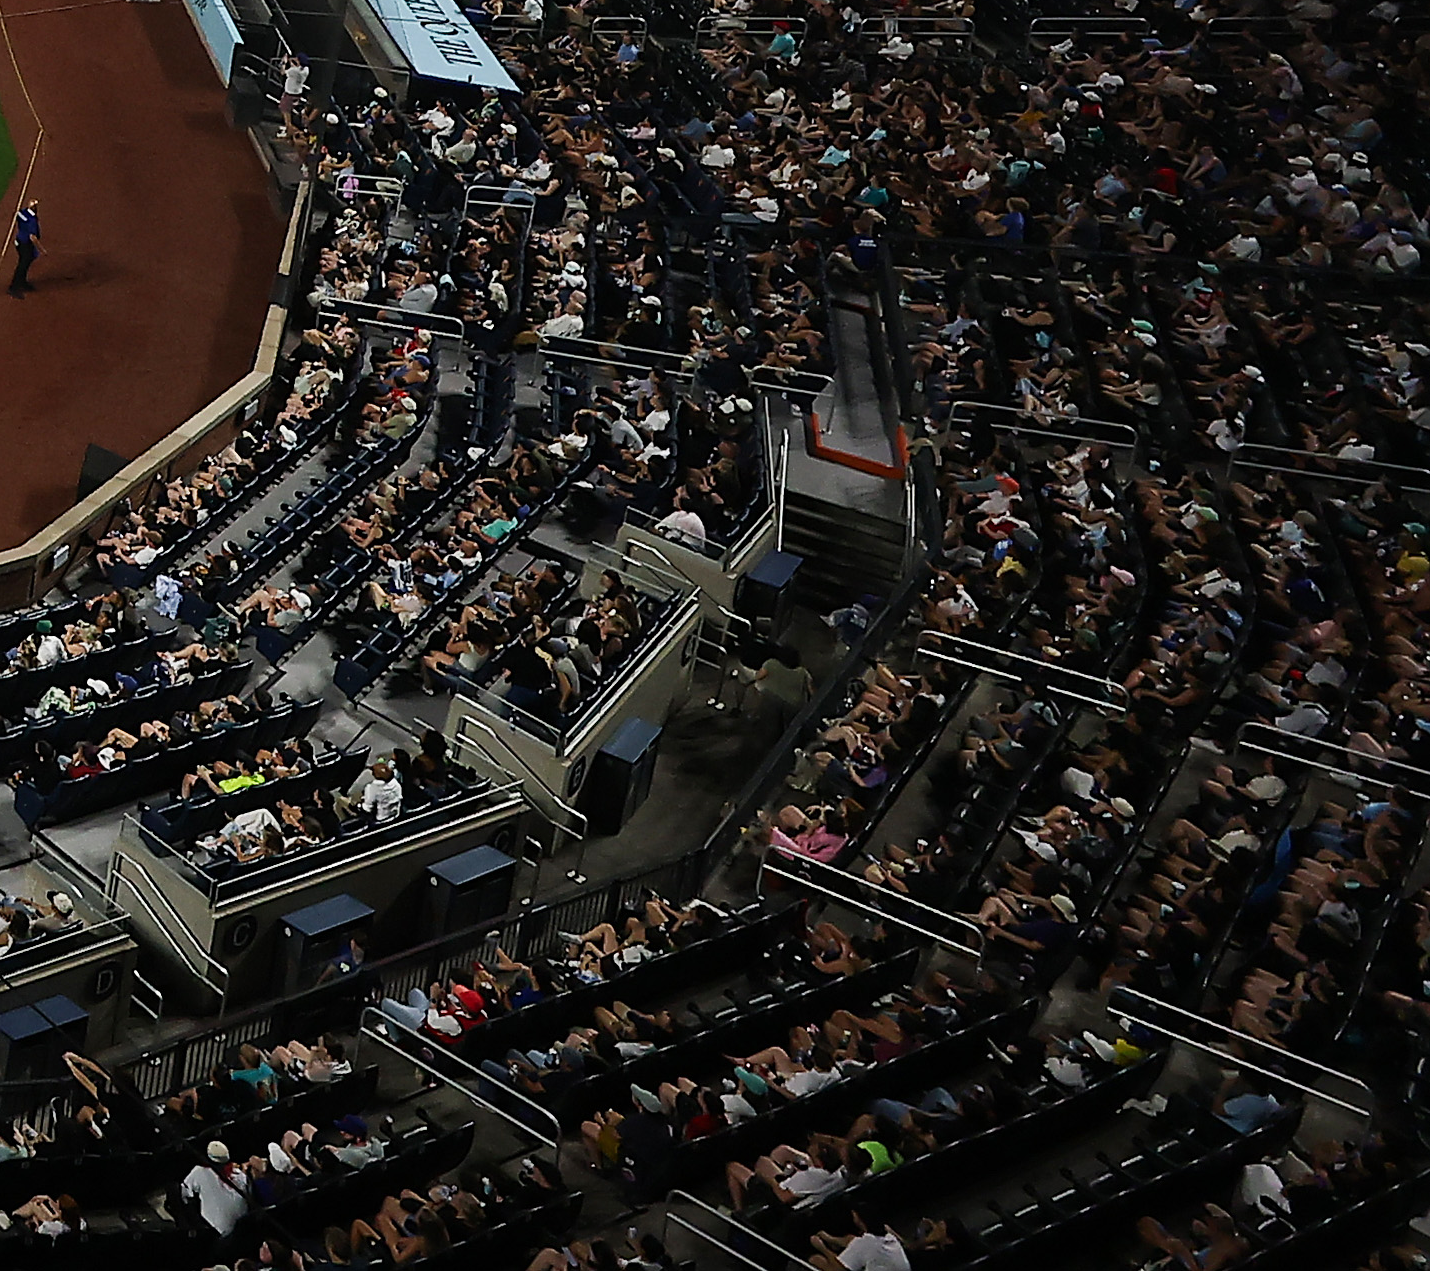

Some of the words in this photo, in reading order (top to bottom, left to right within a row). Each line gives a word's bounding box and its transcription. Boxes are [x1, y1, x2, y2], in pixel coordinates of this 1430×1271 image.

[429, 34, 483, 66] THE
[232, 921, 251, 948] C
[96, 968, 115, 995] D
